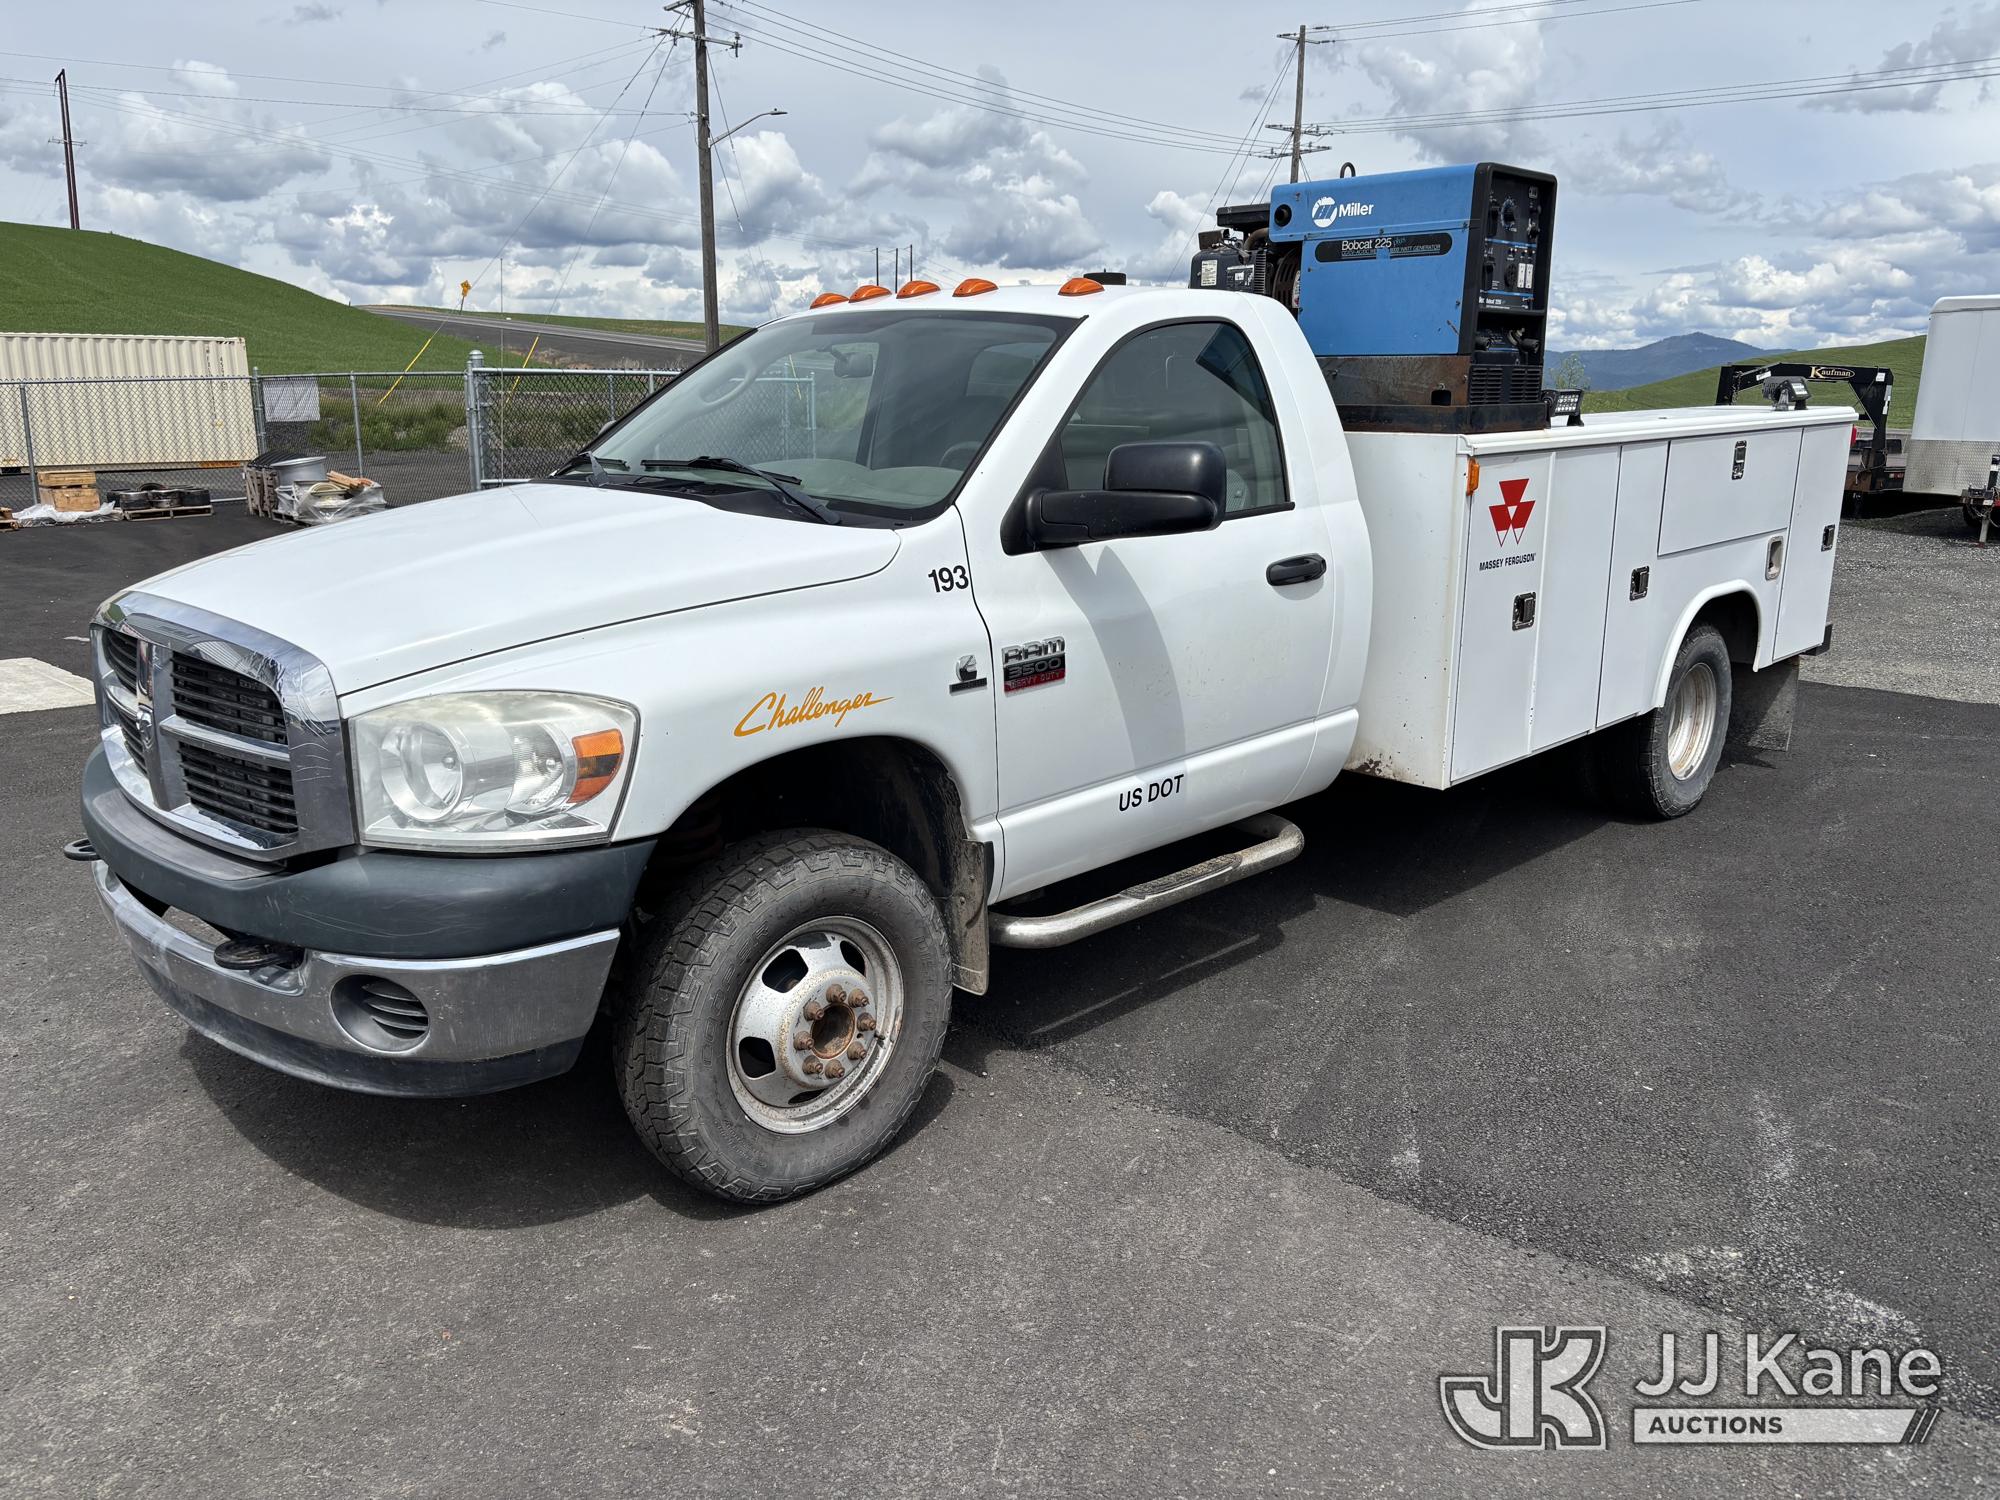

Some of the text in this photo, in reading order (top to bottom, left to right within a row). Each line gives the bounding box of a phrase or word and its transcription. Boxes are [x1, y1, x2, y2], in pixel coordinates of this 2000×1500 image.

[1338, 202, 1374, 218] Miller
[1341, 239, 1372, 251] Bobcat
[1374, 237, 1392, 249] 225
[1412, 243, 1441, 252] GENERATOR
[1809, 366, 1852, 379] Kaufman
[1479, 552, 1535, 571] MASSEY FERGUSON
[927, 564, 970, 593] 193
[1001, 635, 1066, 665] RAM
[1008, 657, 1062, 679] 3500
[1008, 671, 1060, 690] HEAVY DUTY
[733, 685, 894, 738] Challenger
[1118, 774, 1184, 812] US DOT
